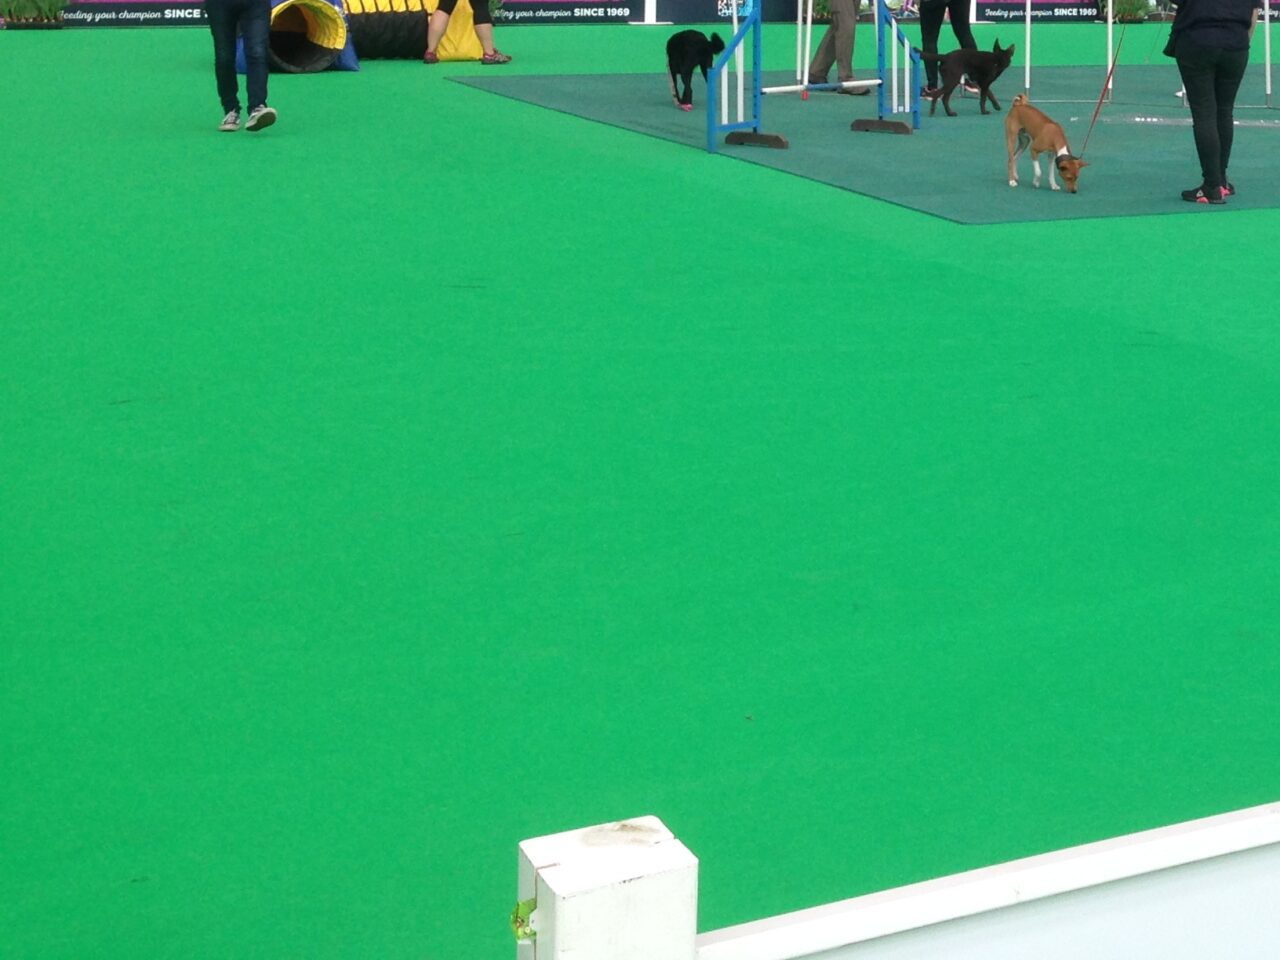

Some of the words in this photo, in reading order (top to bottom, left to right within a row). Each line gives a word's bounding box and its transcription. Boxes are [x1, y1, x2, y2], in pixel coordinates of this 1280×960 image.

[95, 11, 117, 22] your
[118, 9, 161, 21] champion
[164, 8, 201, 18] SINCE
[515, 11, 534, 20] your
[535, 9, 572, 20] champion
[574, 8, 604, 17] SINCE
[606, 7, 630, 17] 1969
[1025, 9, 1053, 18] ampion
[1054, 7, 1077, 16] SINCE
[1079, 7, 1097, 16] 1969
